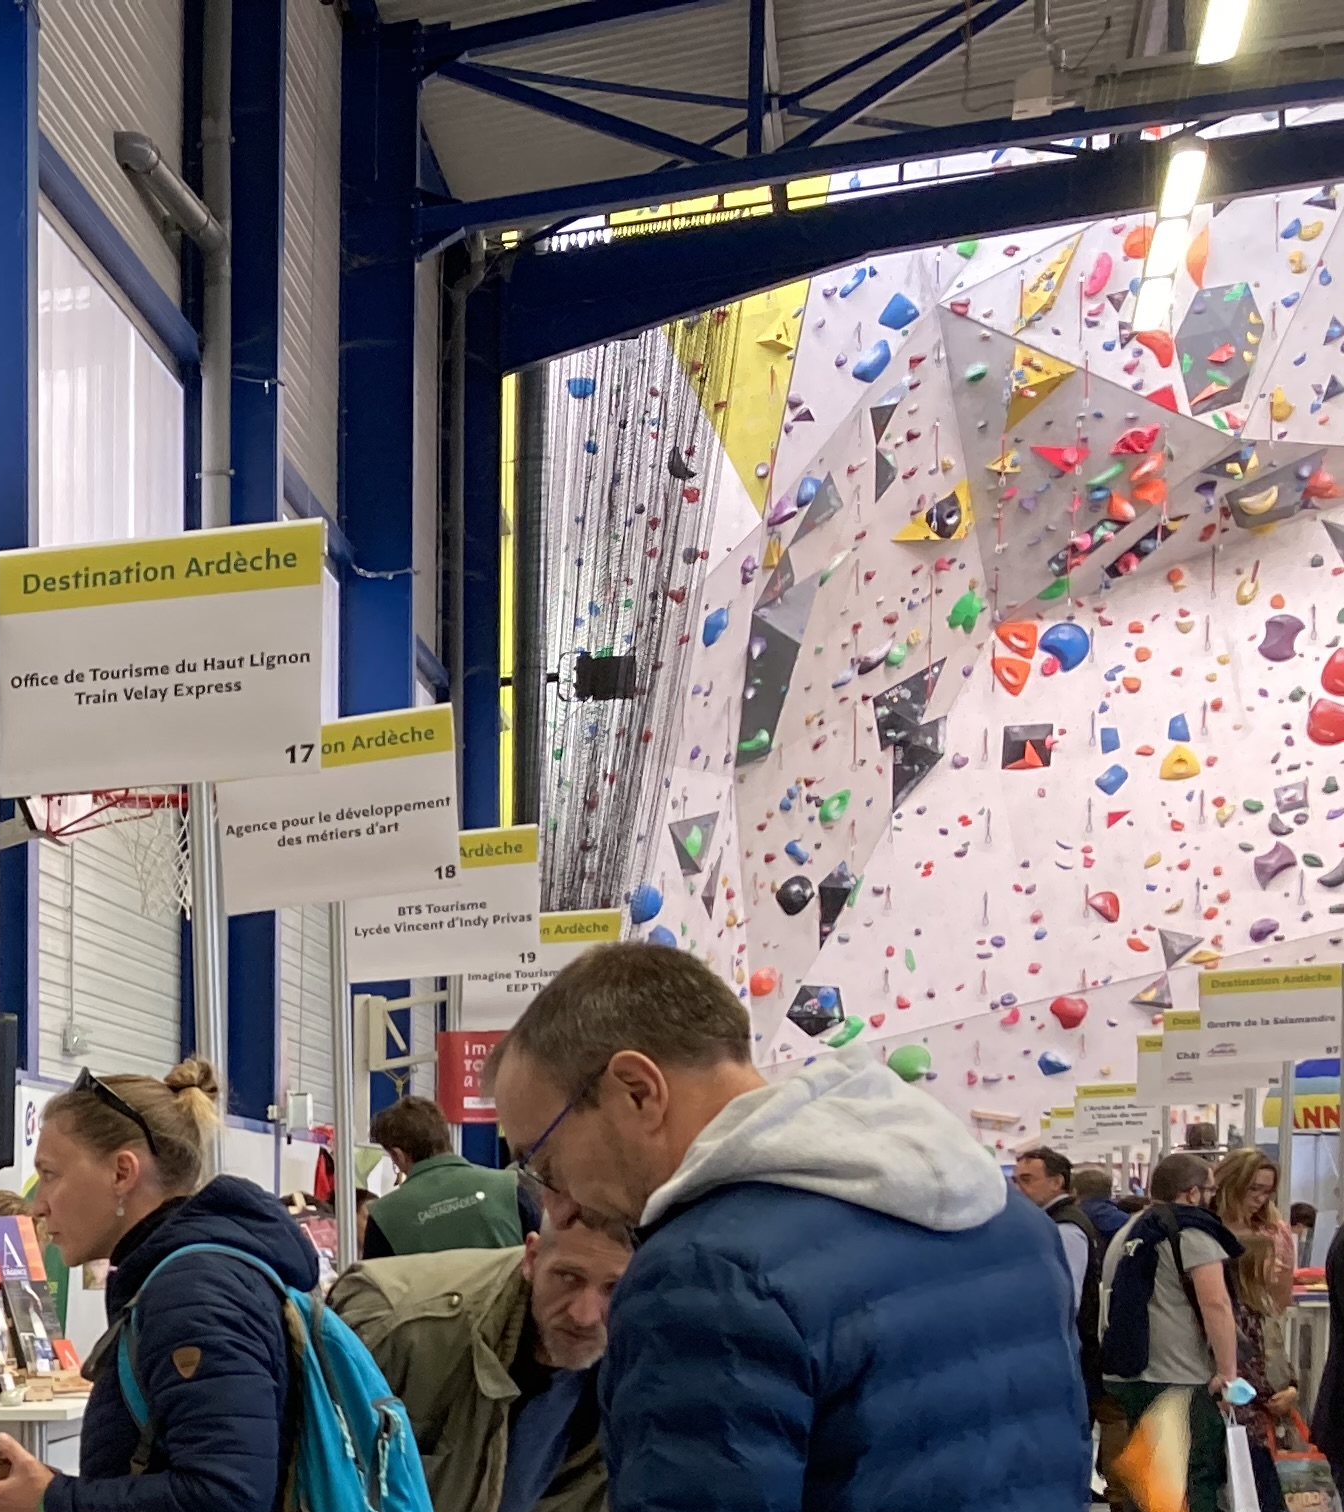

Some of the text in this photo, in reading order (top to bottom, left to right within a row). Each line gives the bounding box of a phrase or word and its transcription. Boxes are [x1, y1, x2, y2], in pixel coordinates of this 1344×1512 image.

[22, 548, 298, 595] Destination Ardèche
[10, 649, 311, 690] Office de Tourisme du Haut Lignon
[74, 678, 242, 707] Train Velay Express
[352, 726, 435, 751] Ardèche
[284, 743, 315, 764] 17
[225, 796, 451, 838] Agence pour le développement
[277, 821, 399, 848] des métiers d'art
[459, 841, 523, 859] Ardèche
[434, 864, 456, 881] 18
[398, 900, 487, 917] BTS Tourisme
[354, 923, 391, 938] Lycée
[394, 918, 444, 933] Vincent
[493, 911, 532, 925] Privas
[554, 921, 609, 936] Ardèche
[518, 952, 536, 963] 19
